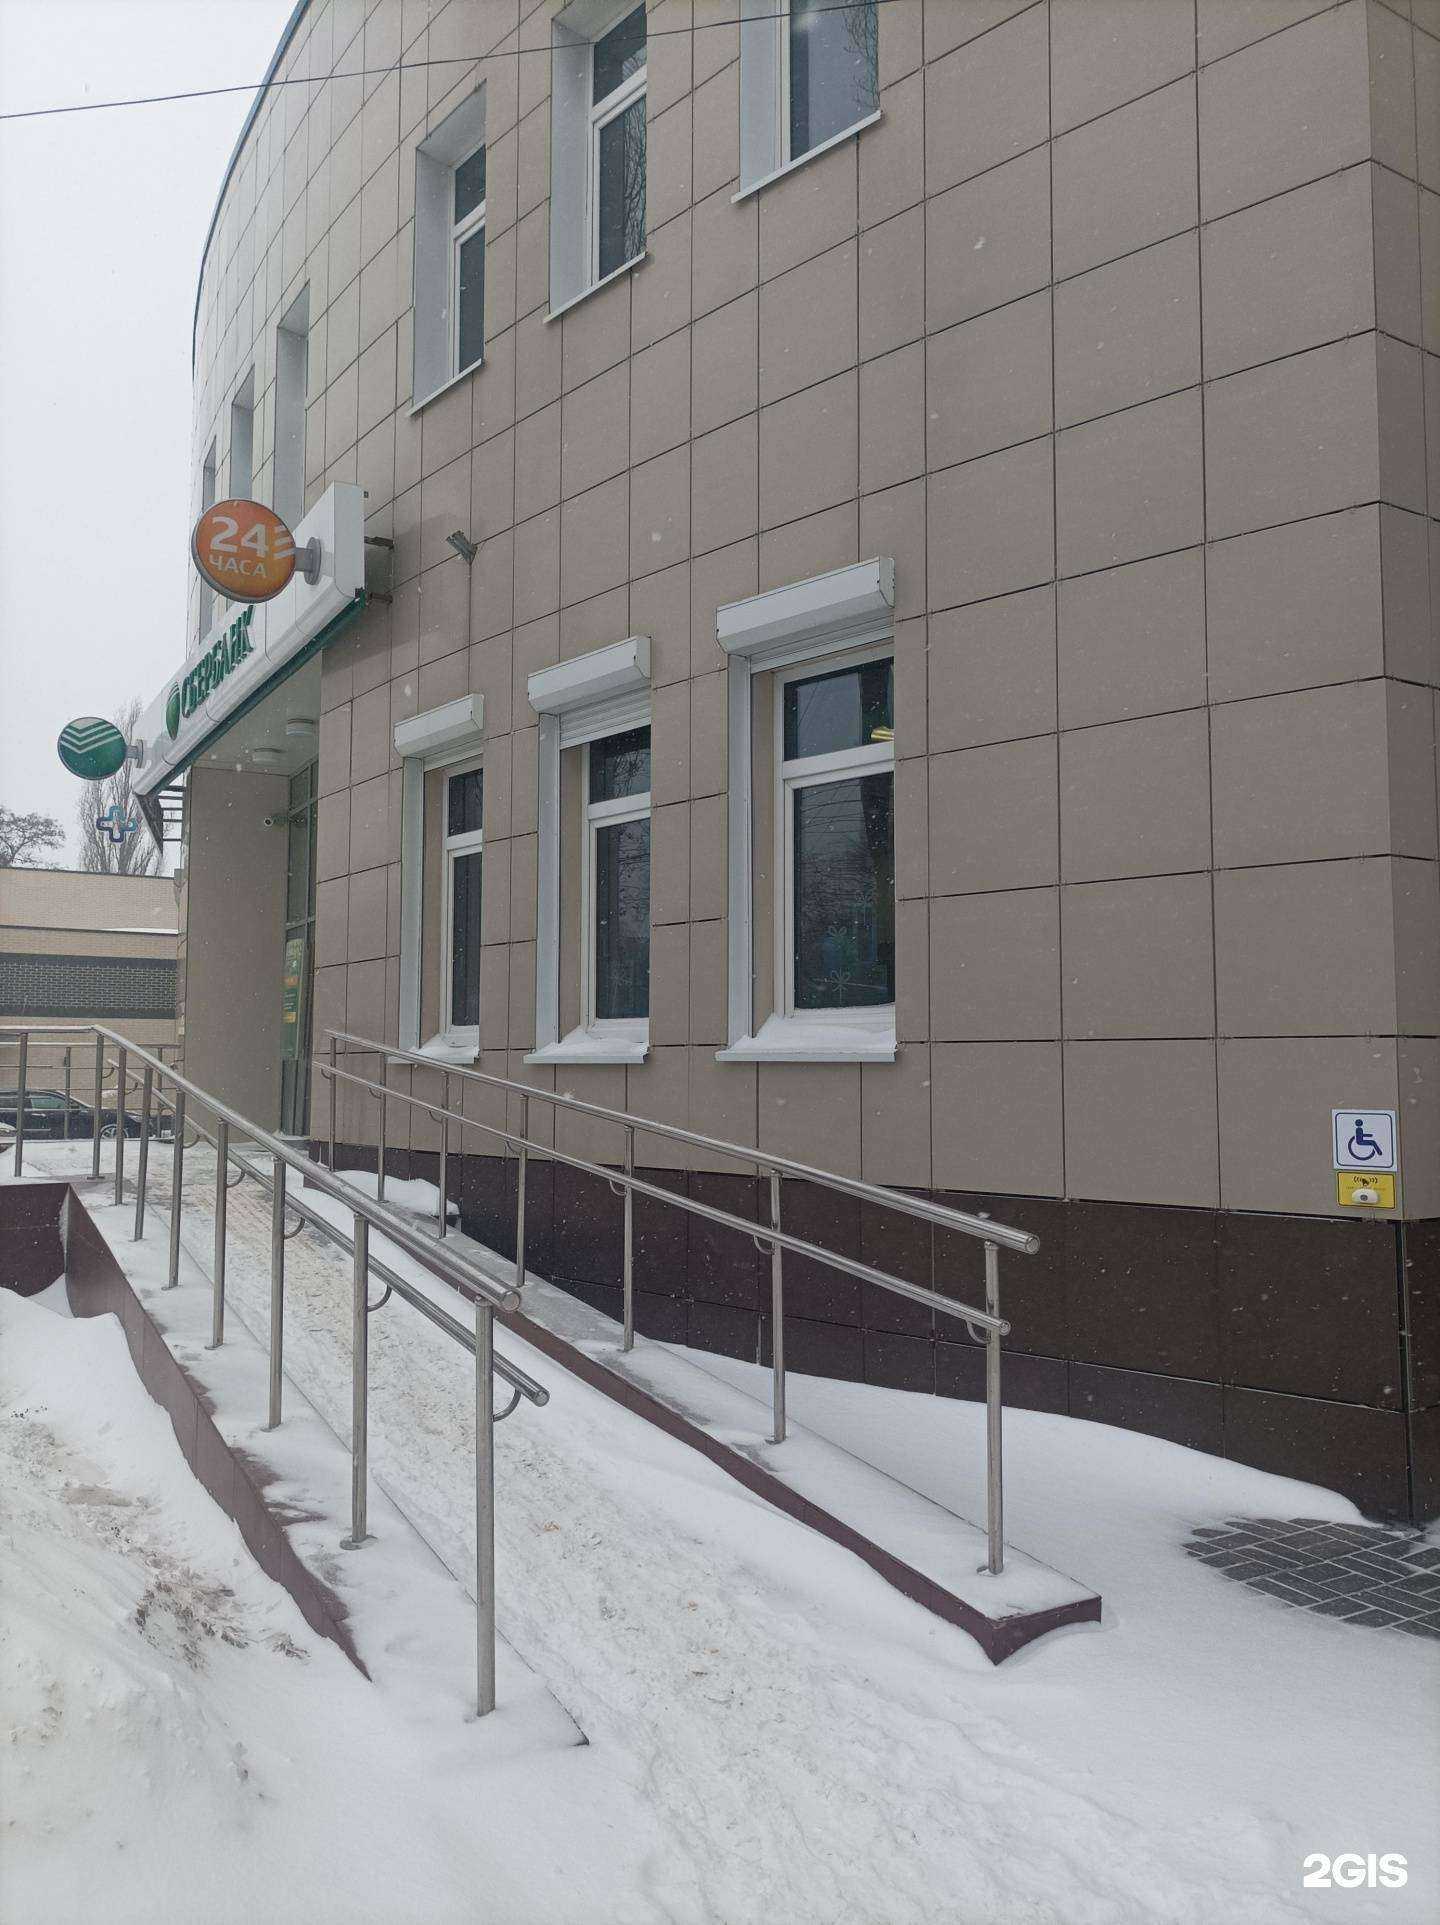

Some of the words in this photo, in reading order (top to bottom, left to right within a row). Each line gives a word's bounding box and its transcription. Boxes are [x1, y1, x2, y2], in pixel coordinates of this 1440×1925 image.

[210, 516, 267, 559] 24
[208, 554, 267, 578] ЧАСА
[181, 604, 253, 718] СБЕРБАНК
